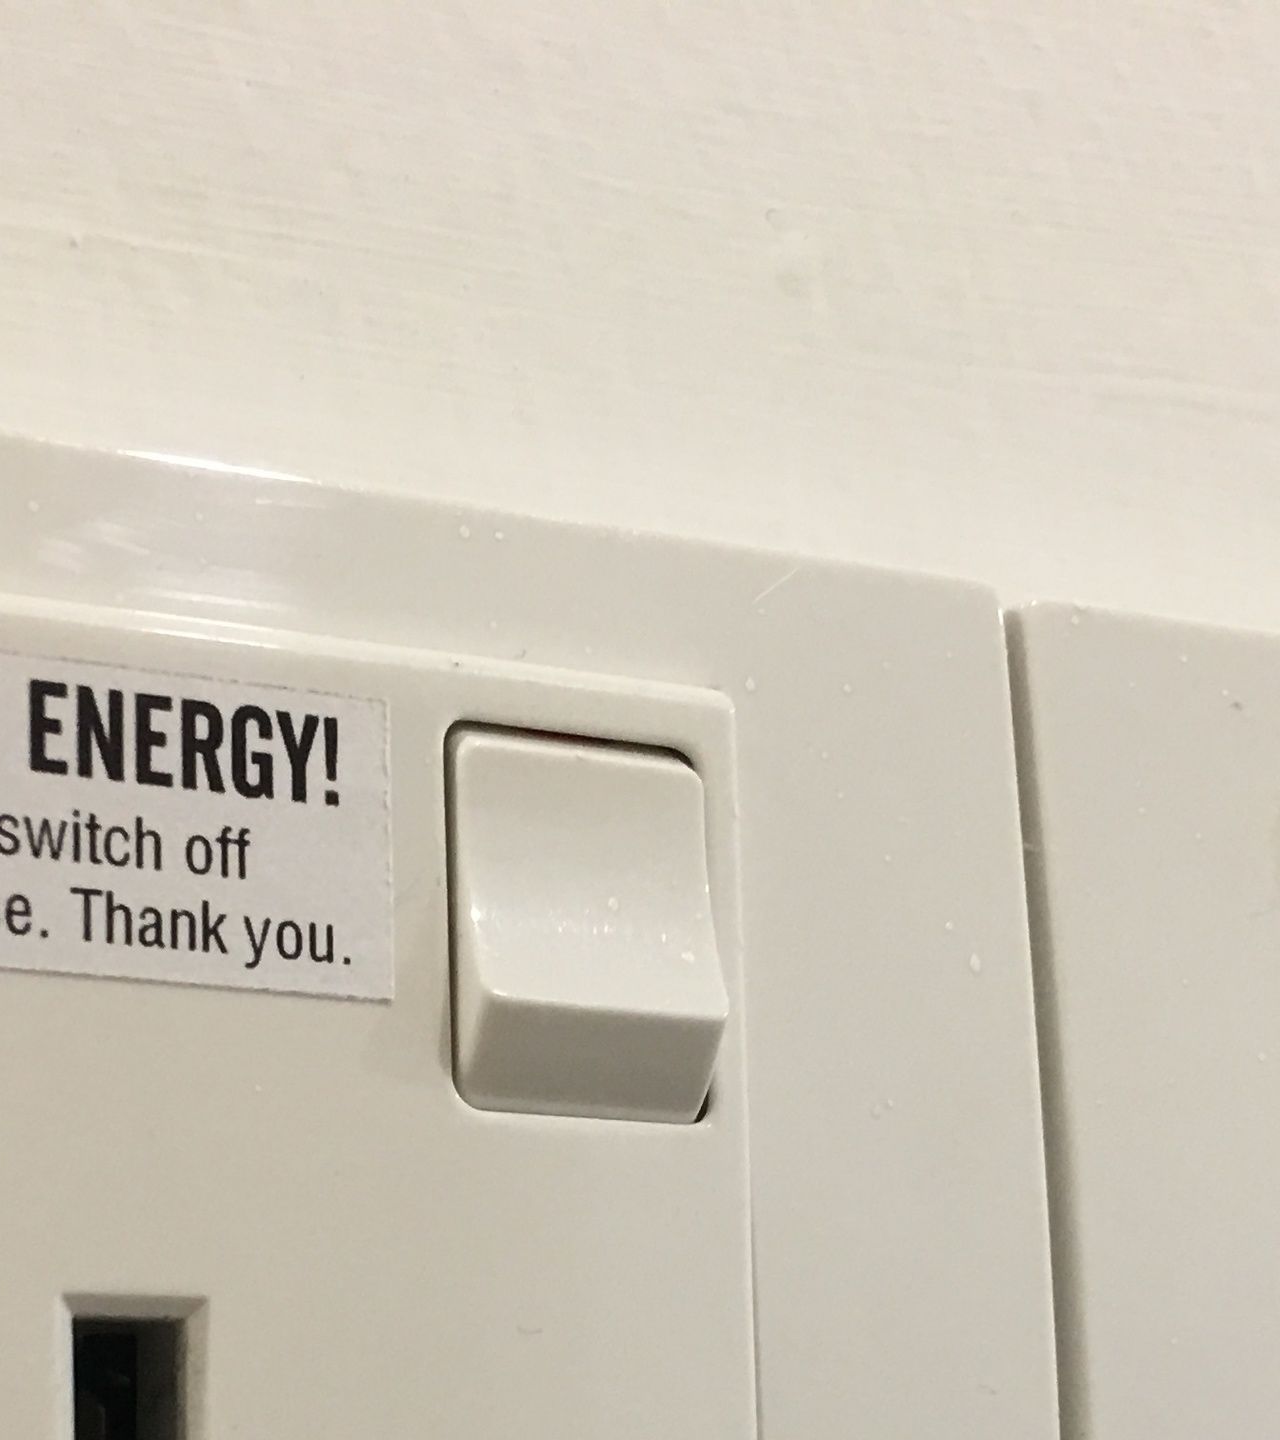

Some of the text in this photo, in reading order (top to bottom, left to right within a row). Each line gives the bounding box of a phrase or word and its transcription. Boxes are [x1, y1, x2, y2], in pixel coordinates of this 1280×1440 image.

[28, 677, 341, 807] ENERGY!
[185, 826, 251, 881] off
[70, 885, 229, 955] Thank
[242, 912, 354, 969] you.
